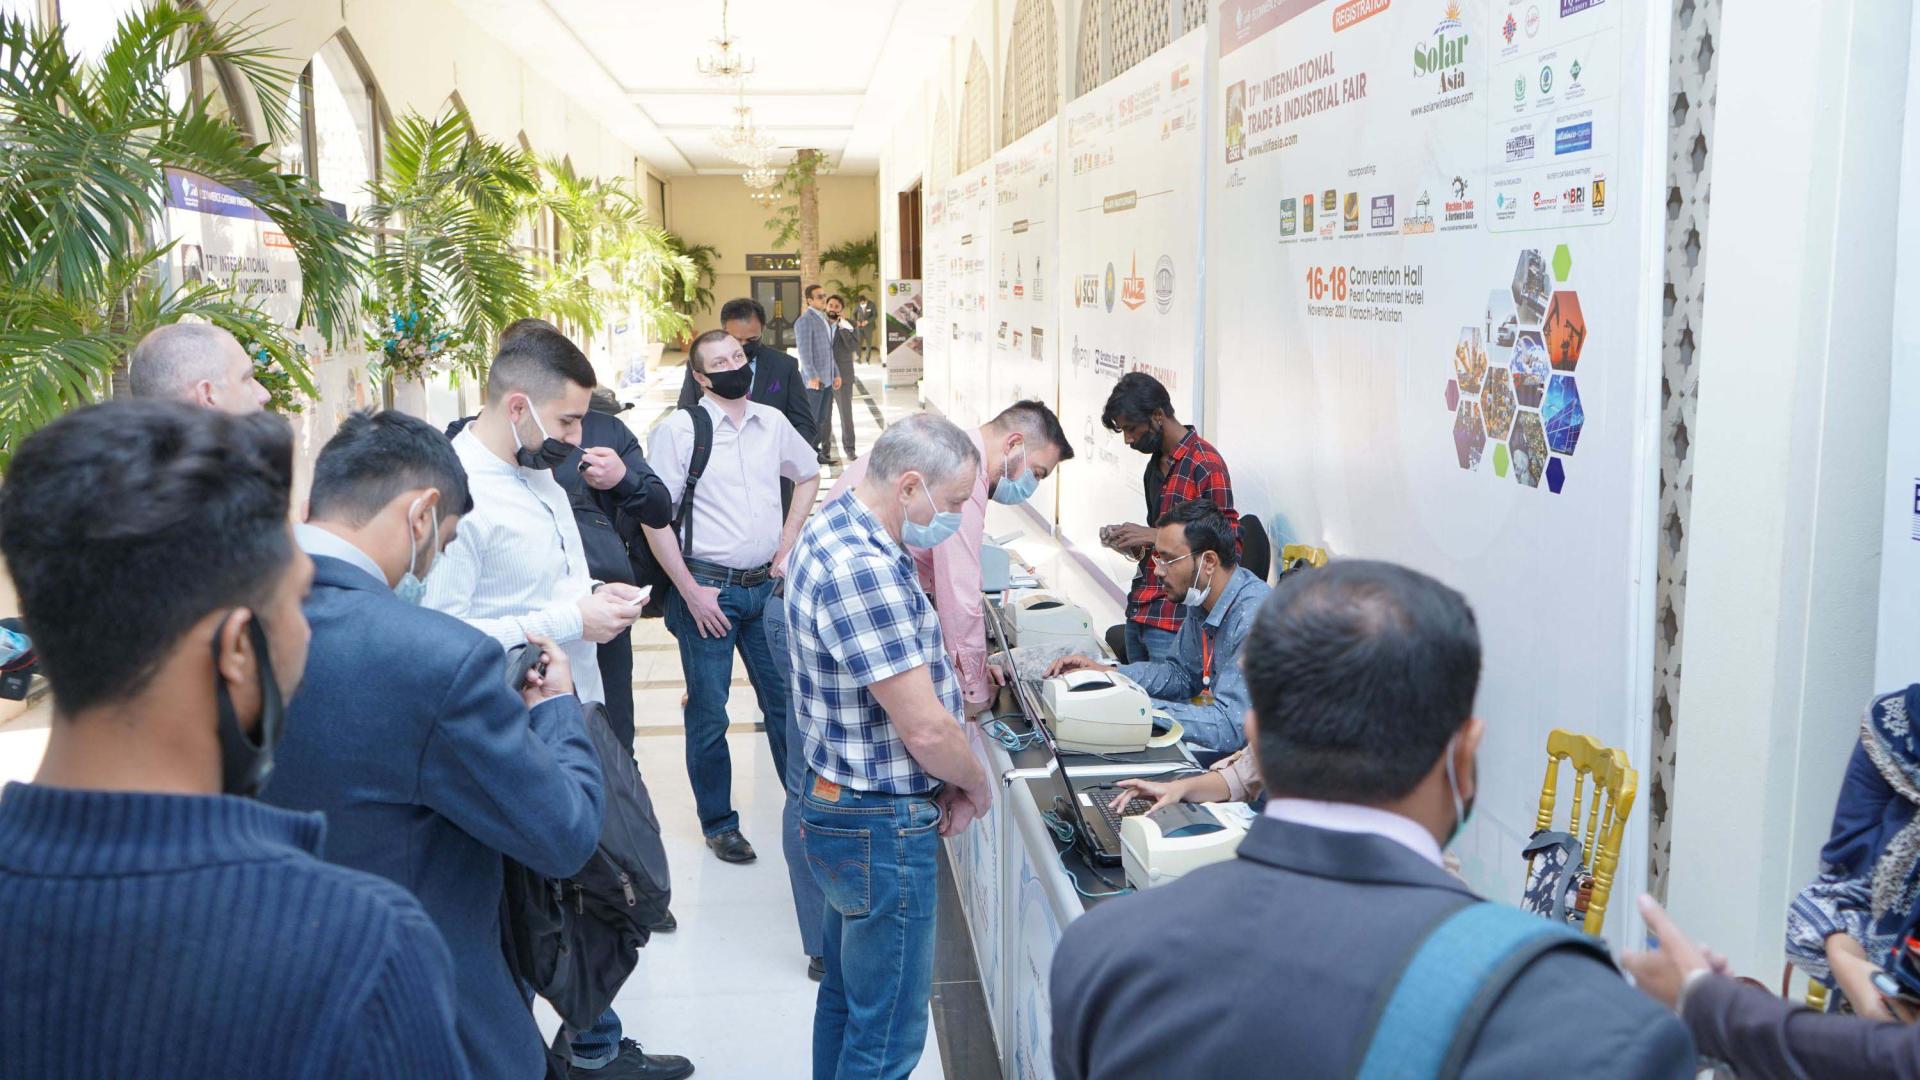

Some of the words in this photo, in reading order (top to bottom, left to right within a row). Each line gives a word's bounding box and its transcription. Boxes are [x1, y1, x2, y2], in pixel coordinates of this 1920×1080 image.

[1413, 33, 1469, 78] Solar
[1263, 51, 1335, 101] INTERNATIONAL
[1438, 67, 1465, 95] Asia
[1247, 108, 1273, 135] TRADE
[1275, 104, 1282, 124] &
[1284, 83, 1340, 123] INDUSTRIAL
[1342, 72, 1367, 104] FAIR
[1410, 92, 1474, 117] www.solarwindexpo.com
[1506, 136, 1535, 150] ENGINEERING
[1445, 201, 1462, 212] Machine
[1462, 199, 1474, 210] Tools
[1306, 266, 1347, 301] 16-18
[1349, 266, 1401, 286] Convention
[1403, 265, 1423, 286] Hall
[899, 283, 912, 292] BG
[1082, 279, 1099, 304] SCST
[1349, 289, 1365, 302] Pearl
[1365, 289, 1404, 304] Continental
[1405, 291, 1424, 305] Hotel
[1307, 304, 1334, 316] November
[1335, 305, 1347, 318] 2021
[1349, 306, 1403, 323] Karachi-Pakistan
